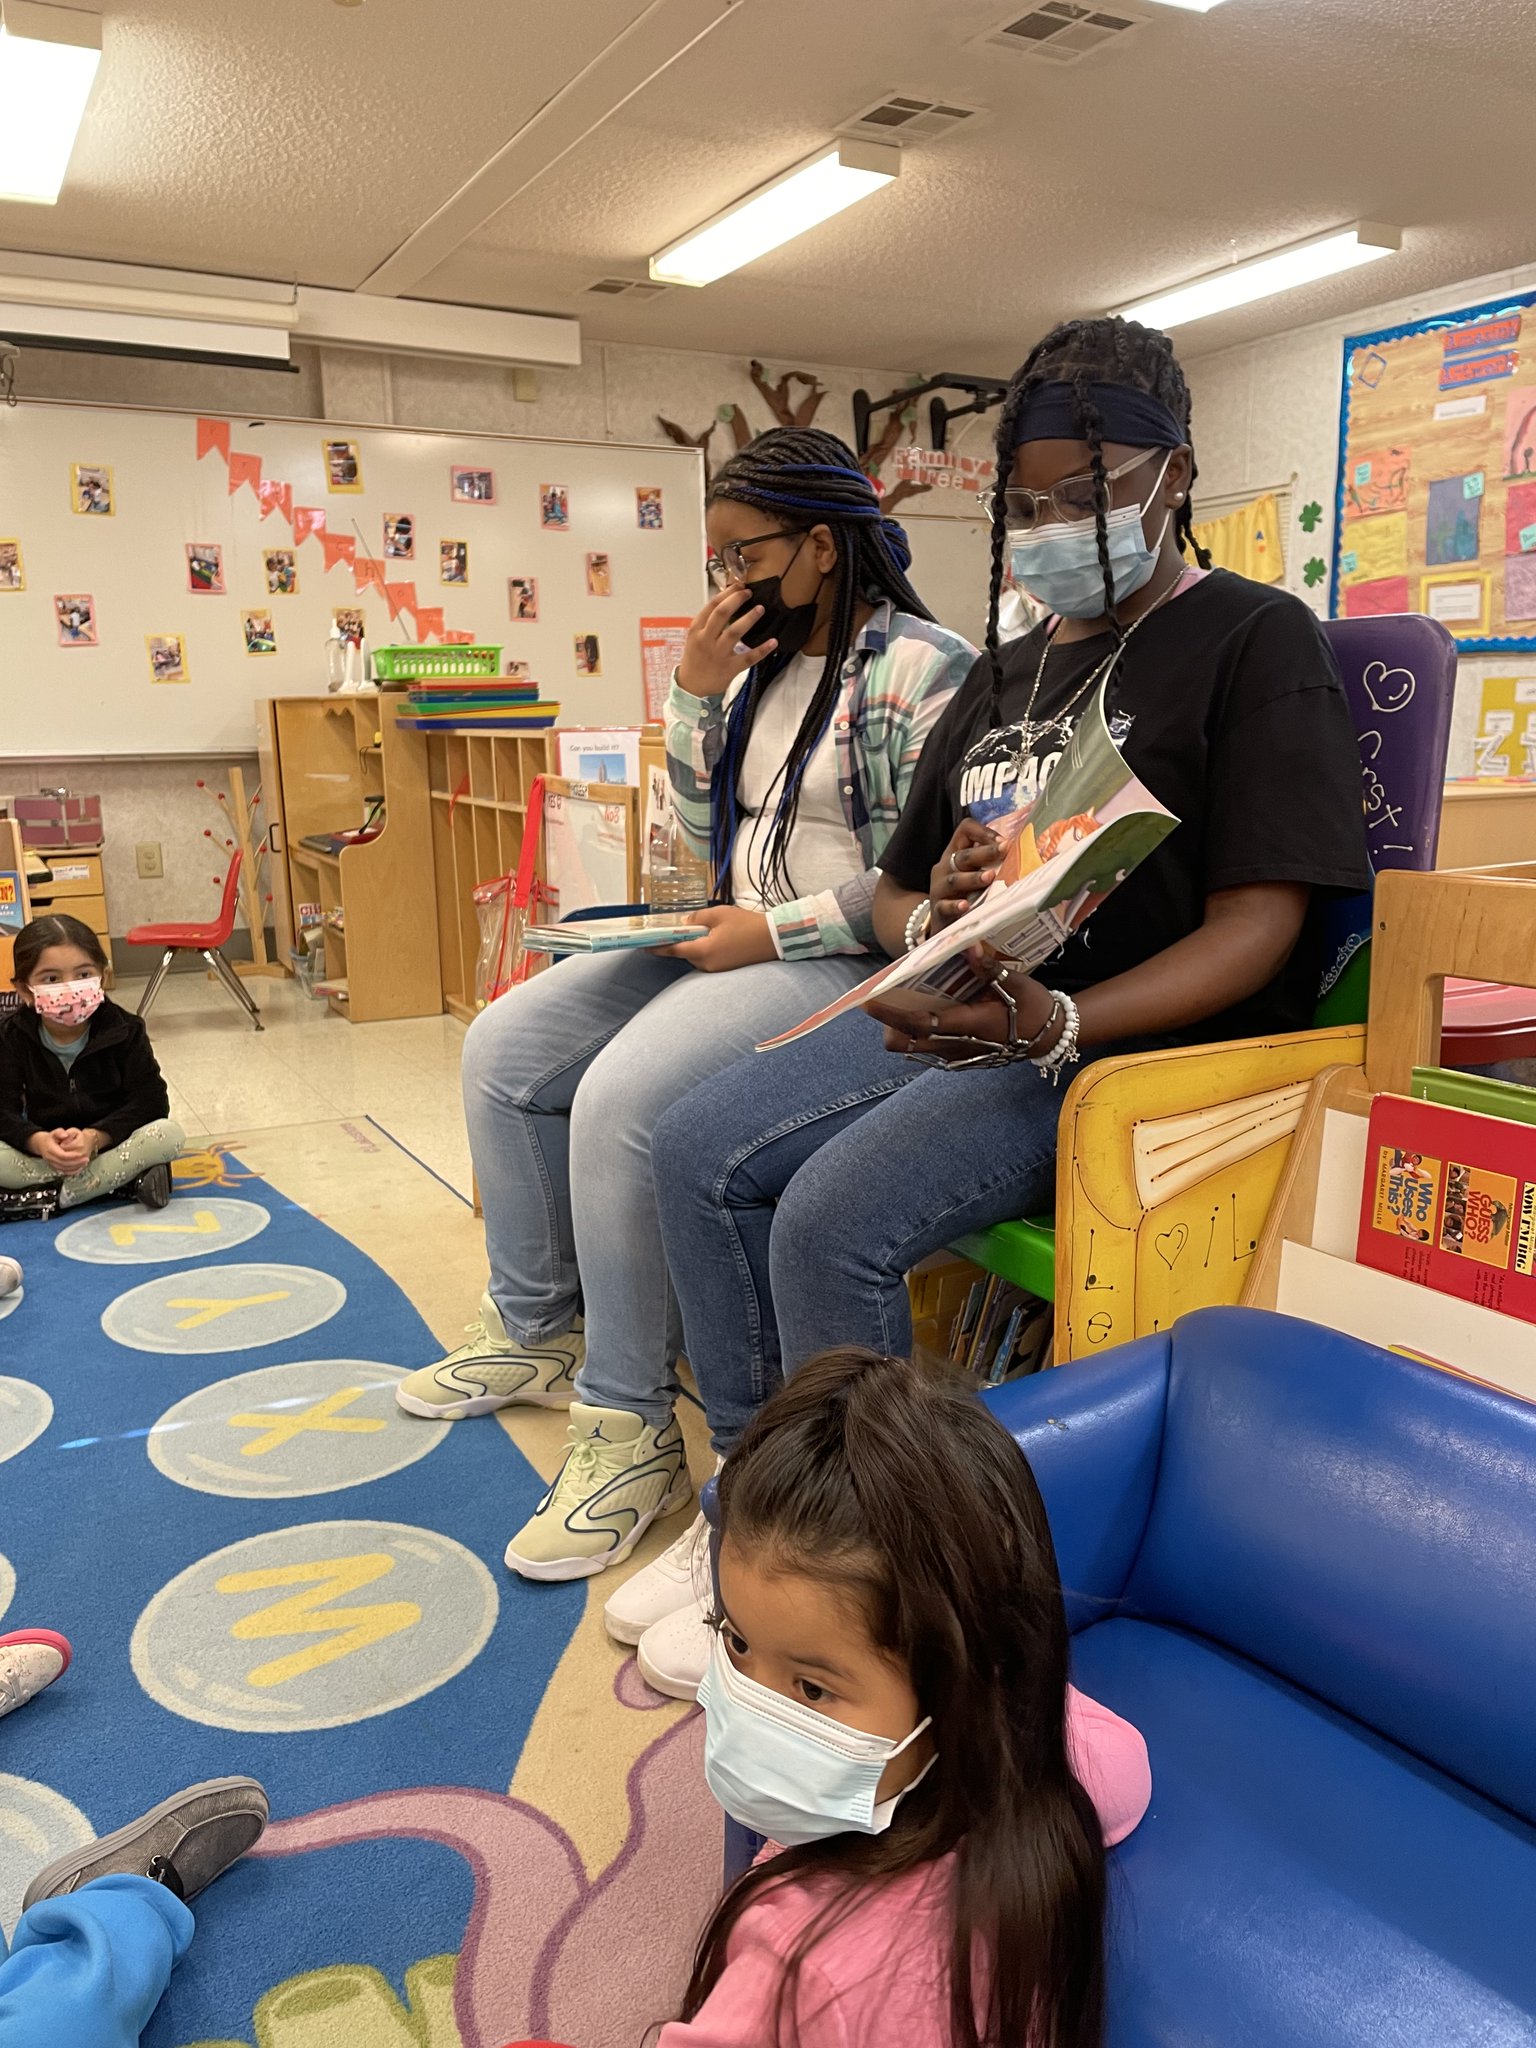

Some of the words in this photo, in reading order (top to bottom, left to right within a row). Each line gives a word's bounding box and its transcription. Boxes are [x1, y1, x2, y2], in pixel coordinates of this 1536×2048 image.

[892, 447, 984, 478] Family
[910, 467, 965, 490] Tree
[569, 744, 582, 752] Can
[582, 745, 594, 753] you
[594, 744, 610, 752] build
[960, 751, 1064, 807] IMPAC
[1380, 1163, 1388, 1199] MARGARET
[1387, 1175, 1404, 1217] This?
[1402, 1178, 1419, 1218] Uses
[1522, 1185, 1535, 1215] NOW
[1417, 1182, 1434, 1222] Who
[1465, 1190, 1481, 1240] WHO?
[1476, 1194, 1492, 1244] GUESS
[109, 1209, 223, 1247] Z
[1516, 1243, 1528, 1270] BIG
[166, 1289, 291, 1330] Y
[227, 1386, 387, 1456] X
[215, 1552, 421, 1688] W
